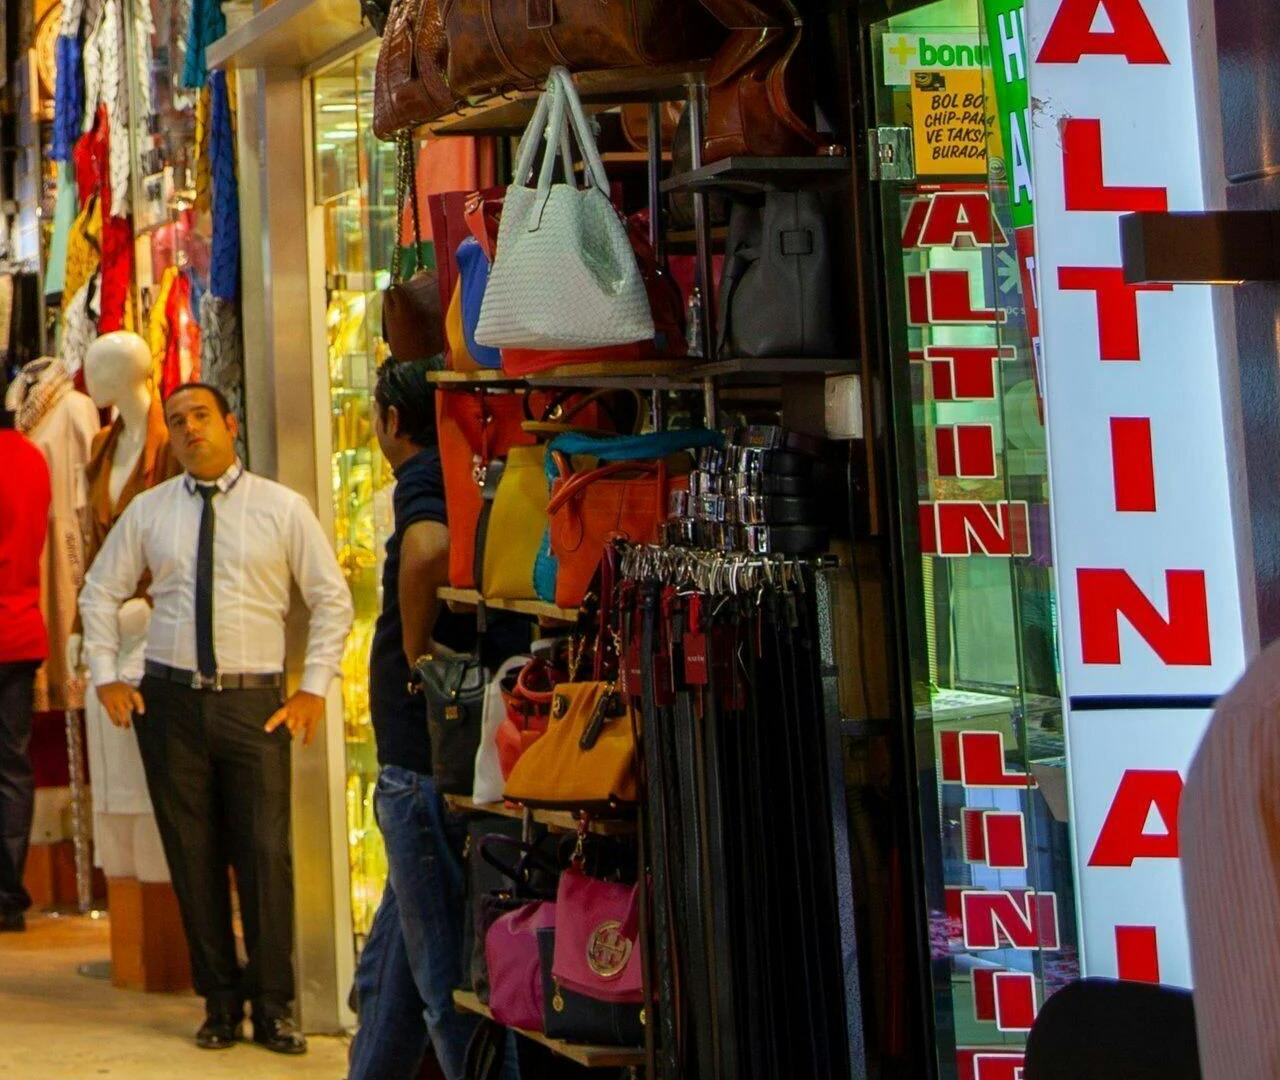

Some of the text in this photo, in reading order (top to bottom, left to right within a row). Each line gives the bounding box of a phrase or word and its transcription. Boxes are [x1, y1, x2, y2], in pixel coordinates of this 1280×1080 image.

[919, 37, 990, 67] bonu
[931, 94, 958, 110] BOL
[926, 128, 944, 144] VE
[916, 191, 1032, 558] ALTIN
